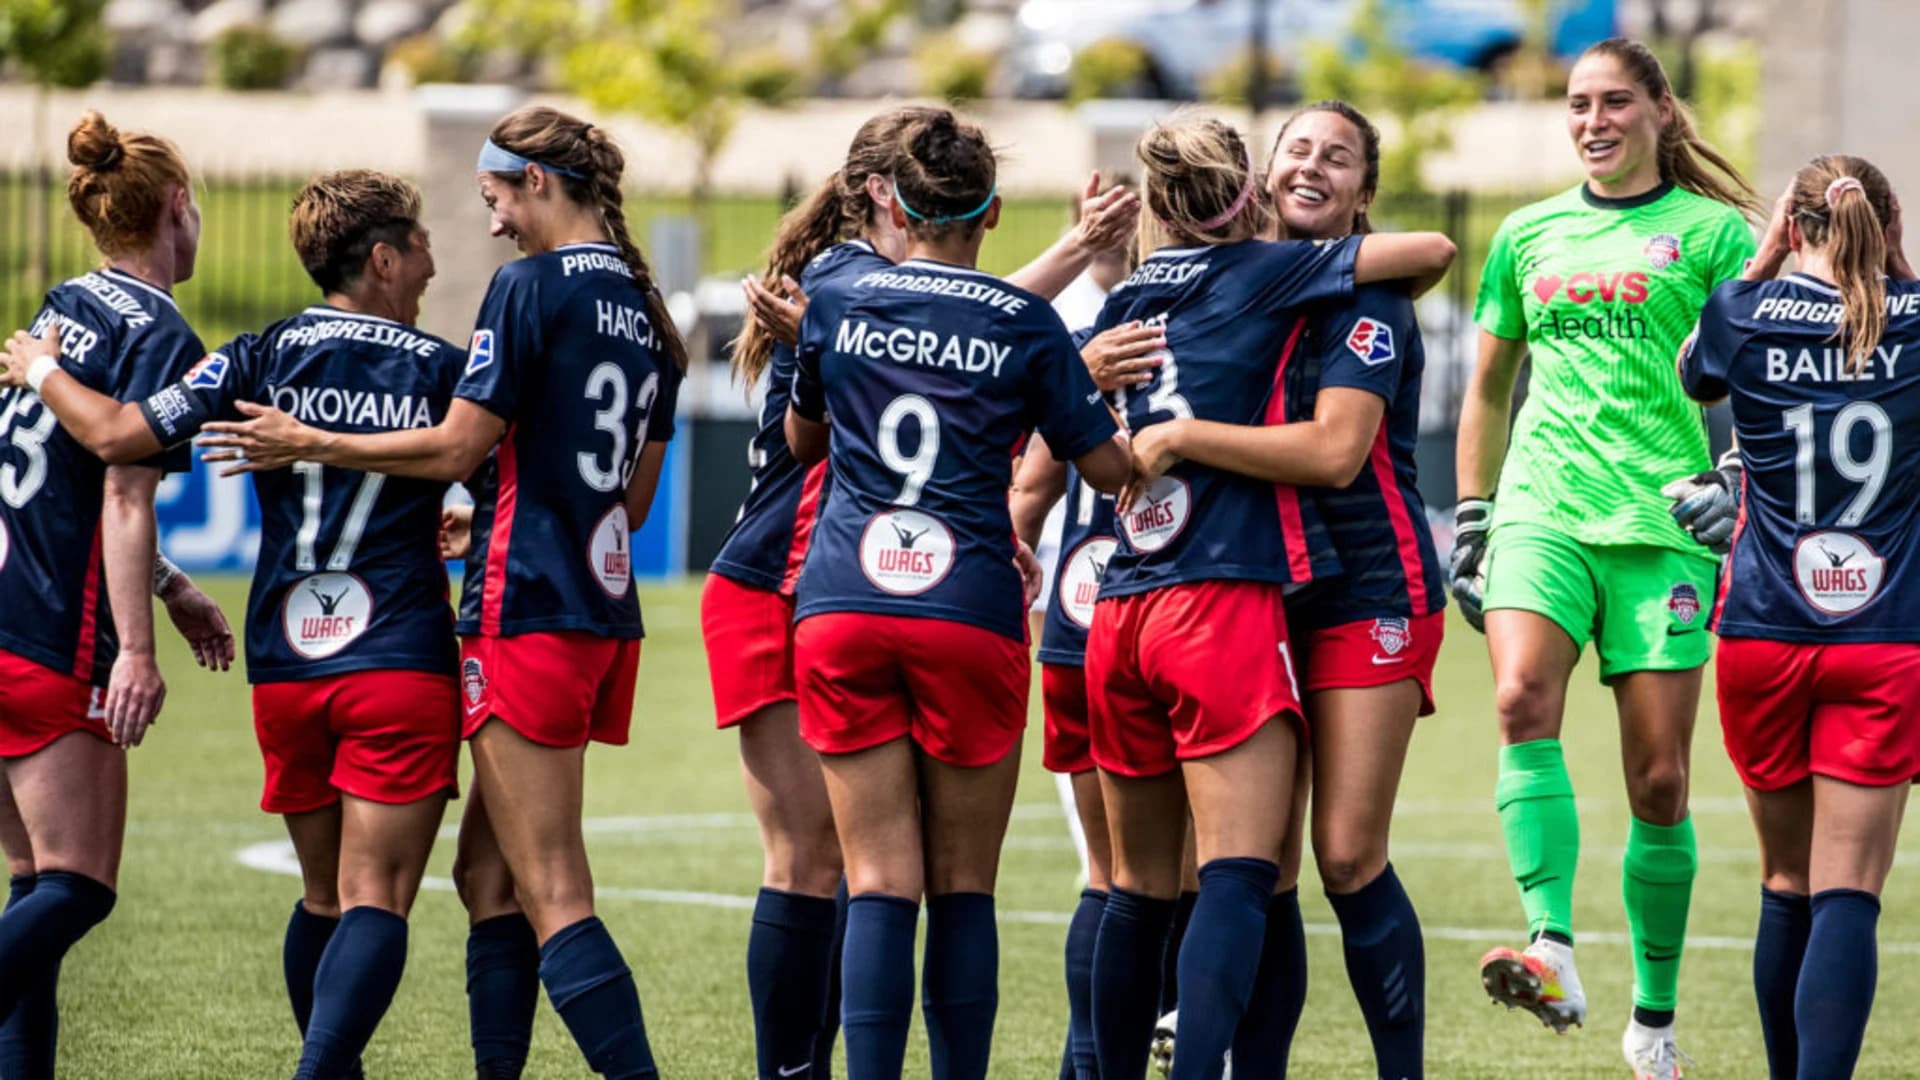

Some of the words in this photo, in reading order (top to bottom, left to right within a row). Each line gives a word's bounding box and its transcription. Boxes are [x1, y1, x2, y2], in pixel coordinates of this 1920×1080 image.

[853, 272, 1029, 316] PROGRESSIVE
[1566, 272, 1649, 304] CVS
[276, 319, 441, 357] PROGRESSIVE
[1537, 308, 1650, 340] Health
[835, 319, 1012, 378] McGRADY
[1766, 345, 1902, 383] BAILEY
[577, 361, 659, 492] 33
[877, 393, 940, 506] 9
[1782, 401, 1893, 527] 19
[292, 460, 387, 571] 17
[1130, 499, 1175, 533] WAGS
[878, 548, 934, 574] WAGS
[1812, 567, 1868, 592] WAGS
[301, 616, 354, 639] WAGS
